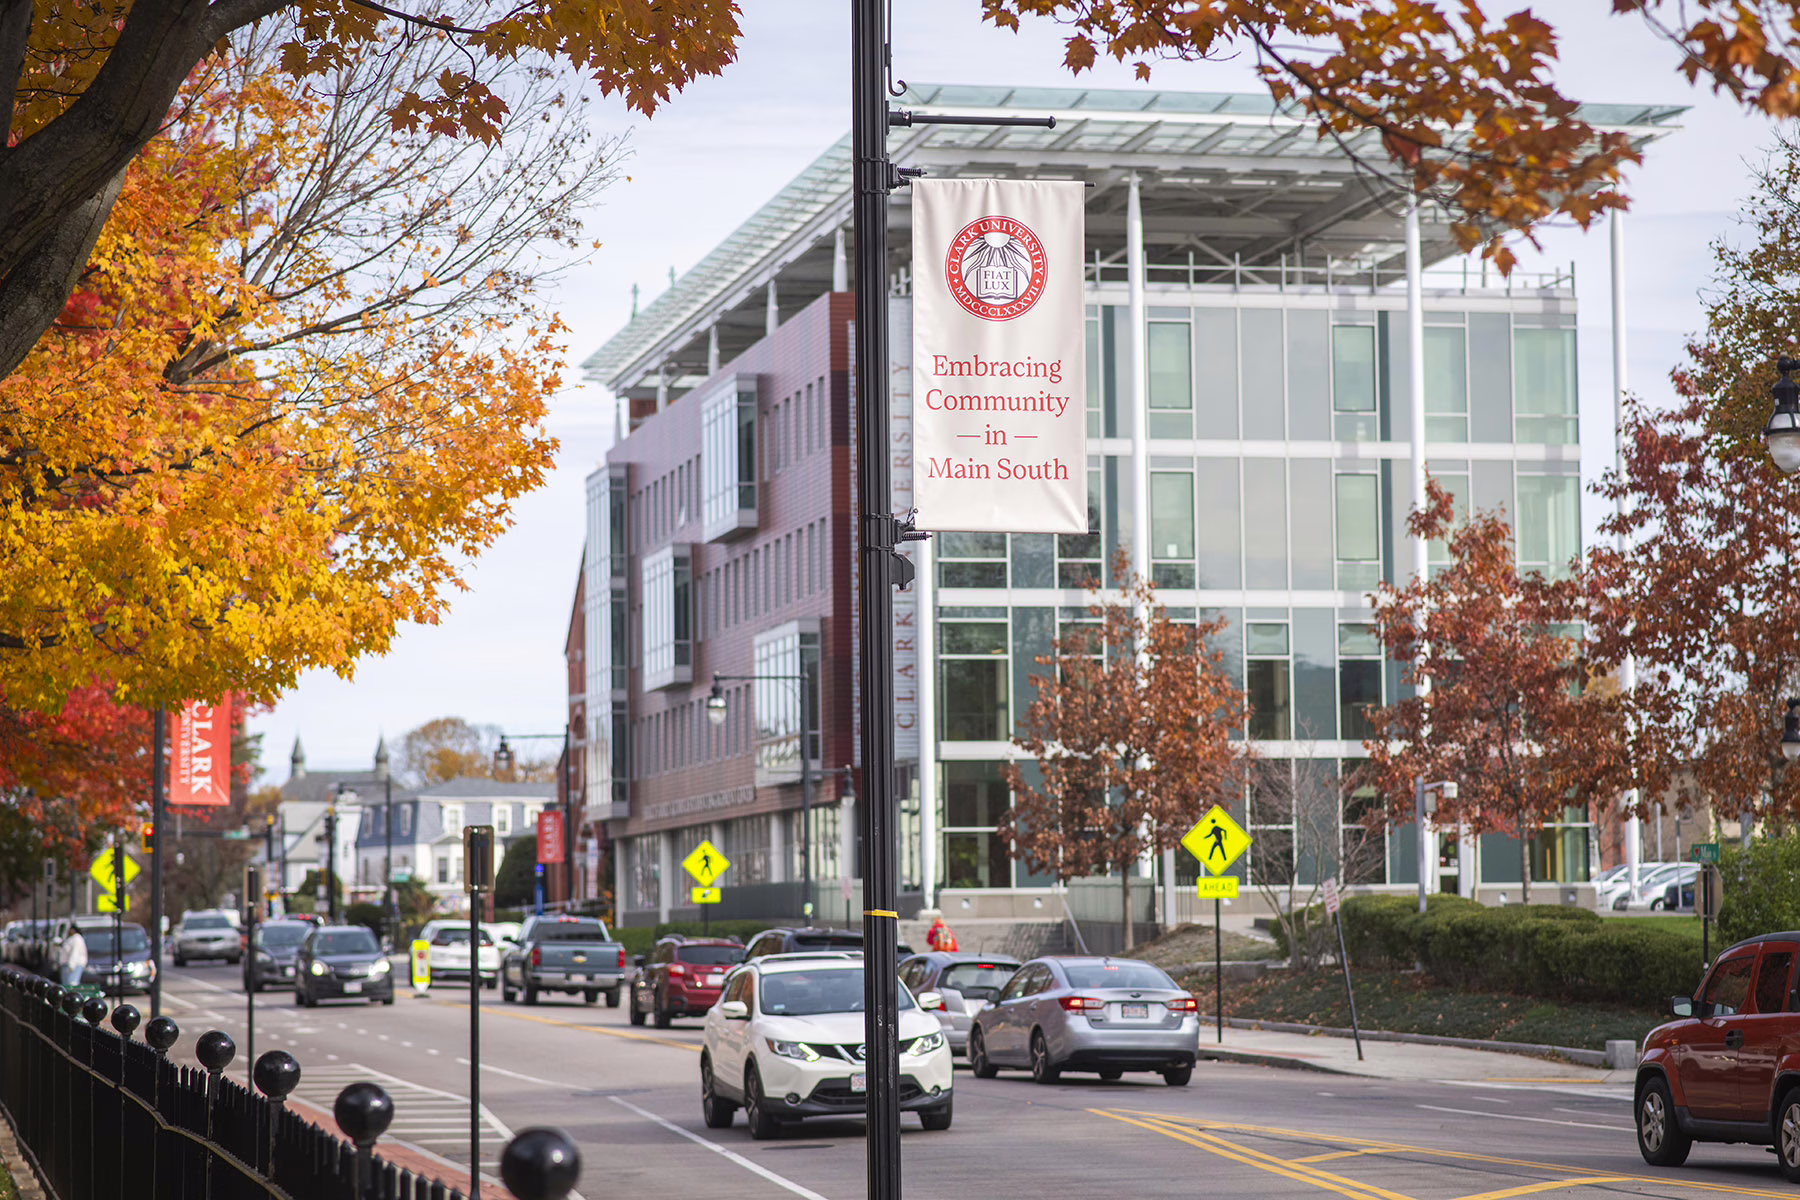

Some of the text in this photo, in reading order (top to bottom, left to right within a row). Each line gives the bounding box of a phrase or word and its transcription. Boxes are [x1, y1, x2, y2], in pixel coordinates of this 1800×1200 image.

[949, 220, 1044, 276] CLARK UNIVERSITY
[984, 270, 1011, 280] FIAT
[984, 281, 1010, 290] LUX
[955, 285, 1040, 317] MDCCCLXXXVII
[934, 354, 1062, 384] Embracing
[926, 390, 1070, 418] Community
[986, 424, 1008, 445] in
[928, 458, 1068, 480] Main South
[896, 612, 914, 729] CLARK
[191, 699, 214, 794] CLARK
[1203, 882, 1233, 892] AHEAD
